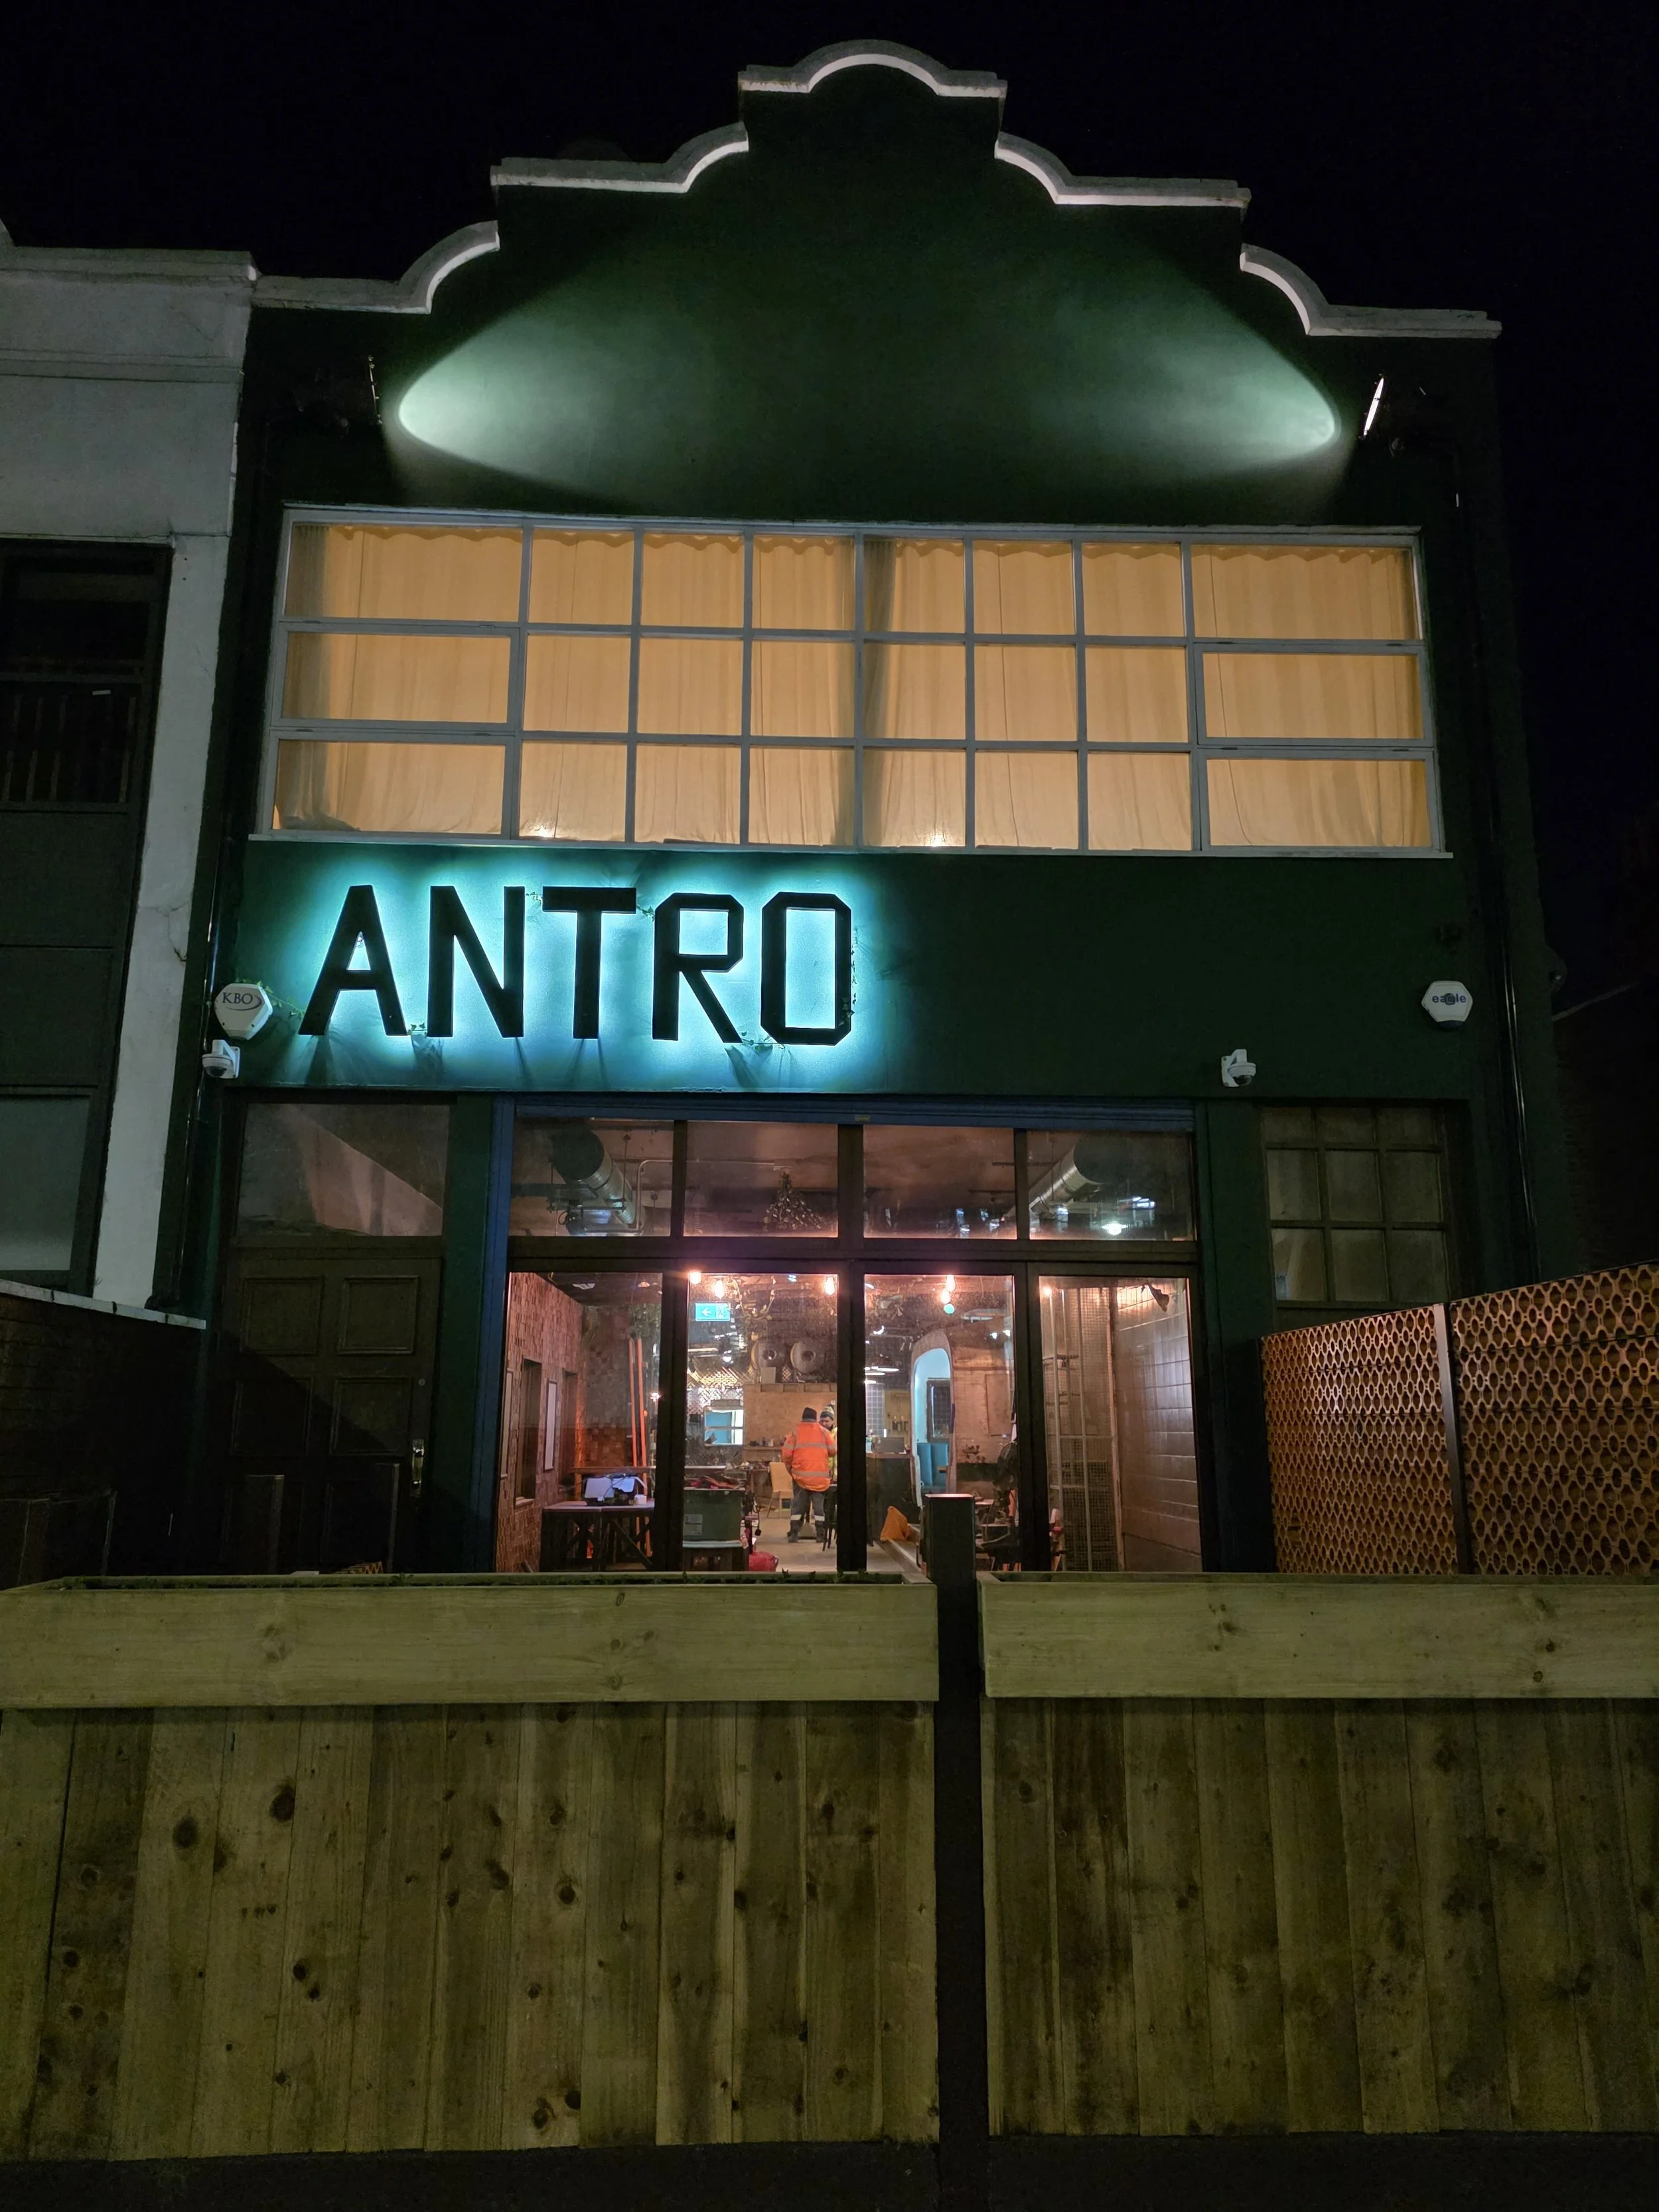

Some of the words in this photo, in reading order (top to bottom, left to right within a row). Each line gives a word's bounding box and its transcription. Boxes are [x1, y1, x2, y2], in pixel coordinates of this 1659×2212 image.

[299, 885, 851, 1045] ANTRO
[222, 992, 253, 1004] KBO
[1432, 993, 1467, 1005] eagle
